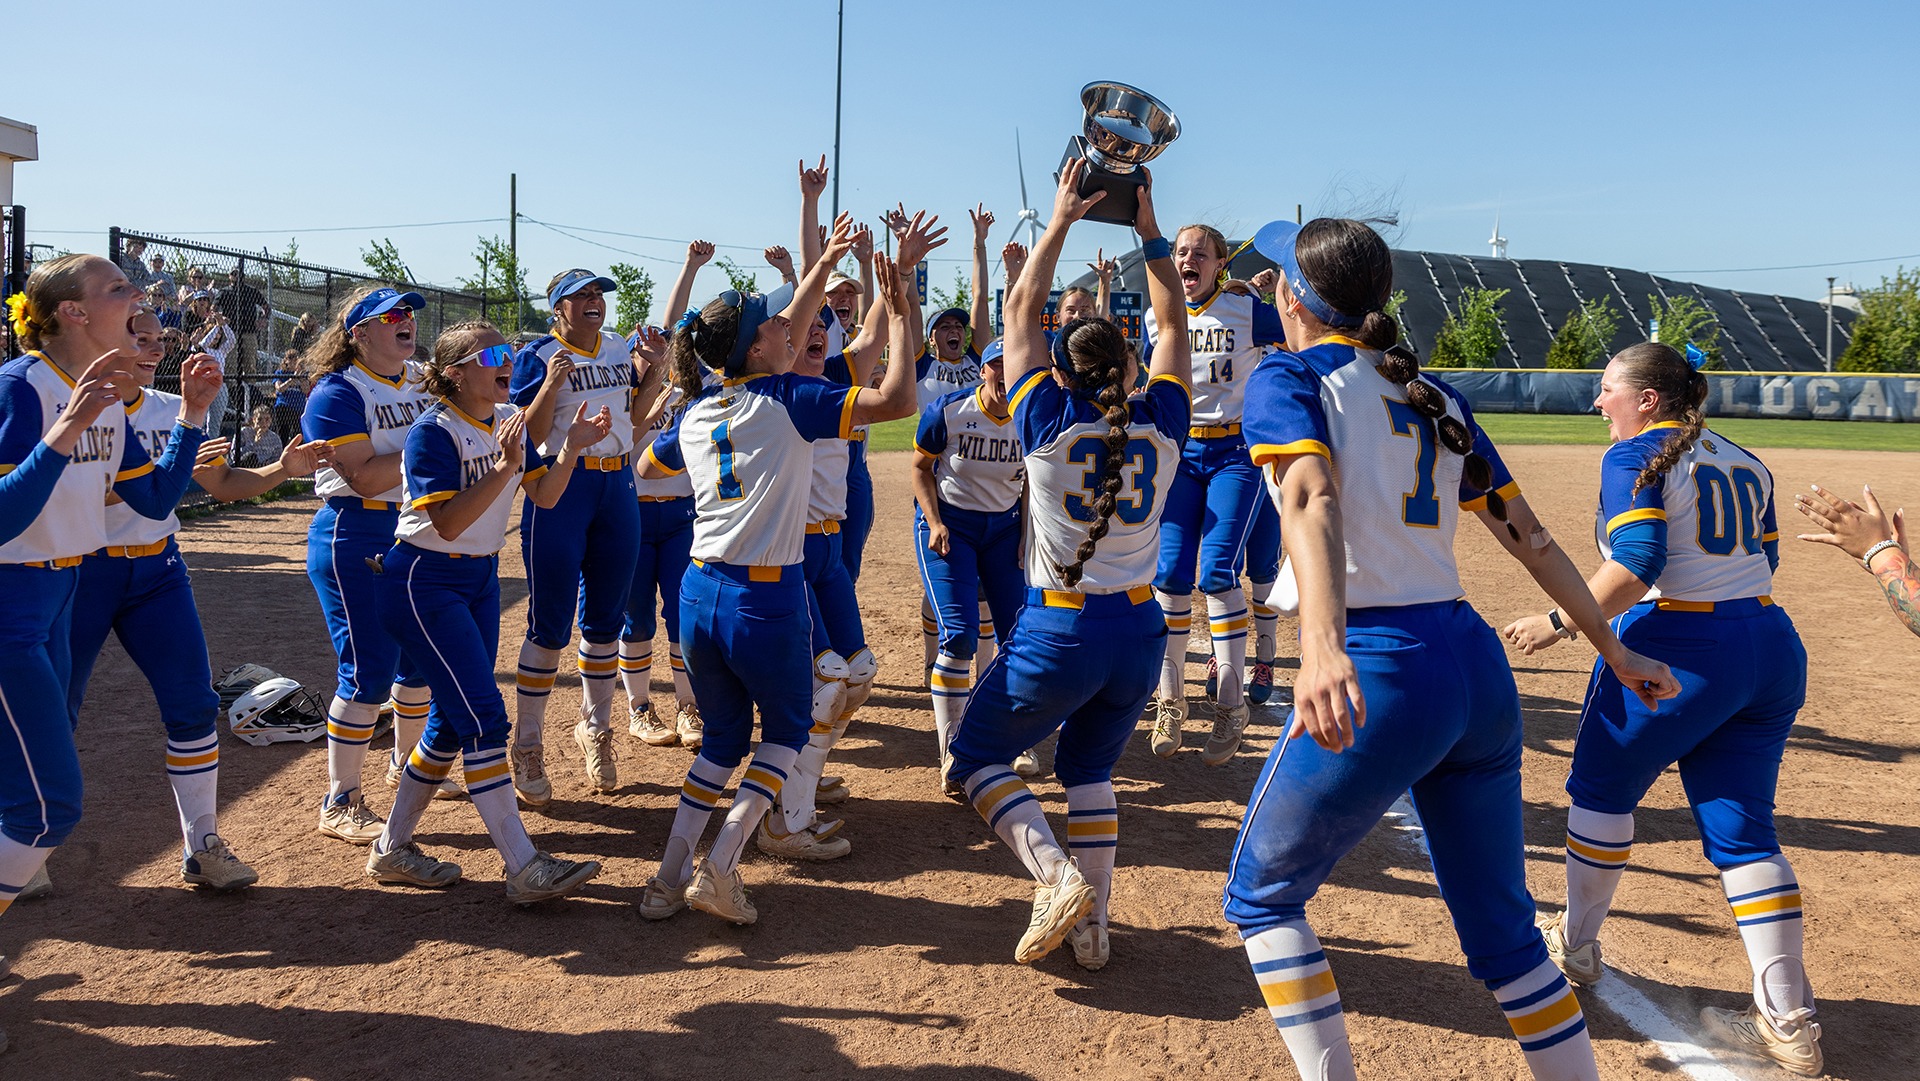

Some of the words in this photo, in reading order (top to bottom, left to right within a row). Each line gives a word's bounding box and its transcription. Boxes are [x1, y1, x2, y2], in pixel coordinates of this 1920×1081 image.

[1208, 358, 1234, 384] 14
[710, 417, 746, 502] 1
[958, 434, 1023, 463] WILDCAT
[1062, 435, 1159, 527] 33
[1380, 394, 1441, 529] 7
[1691, 462, 1766, 556] 00
